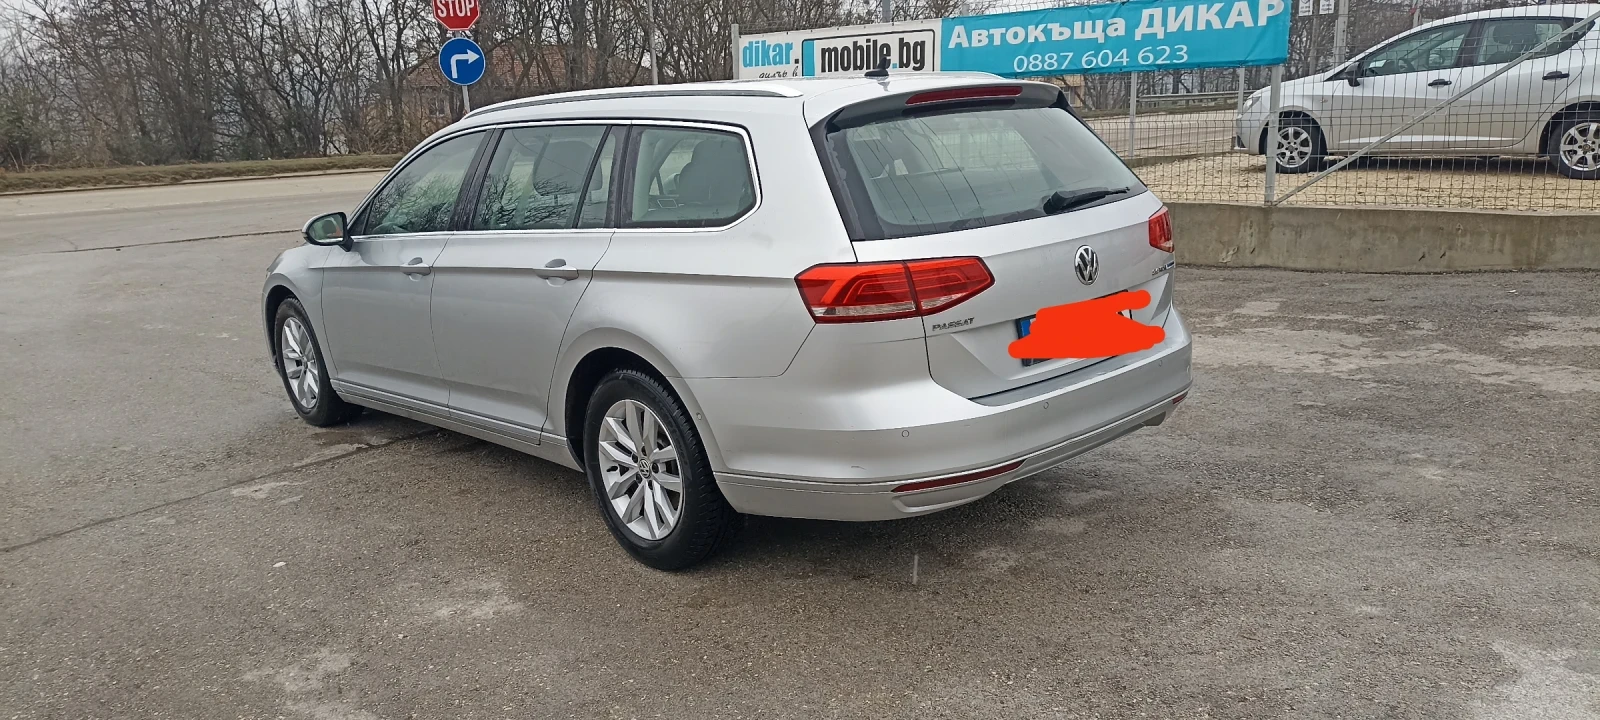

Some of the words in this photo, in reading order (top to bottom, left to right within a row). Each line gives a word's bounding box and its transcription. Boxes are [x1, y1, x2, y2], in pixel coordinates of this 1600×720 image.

[437, 0, 475, 17] STOP
[948, 16, 1126, 49] Автокъща
[1134, 0, 1285, 41] ДИКАР
[821, 37, 926, 73] mobile.bg
[1013, 52, 1074, 73] 0887
[1081, 48, 1130, 69] 604
[1137, 44, 1188, 65] 623
[932, 316, 975, 331] PASSAT
